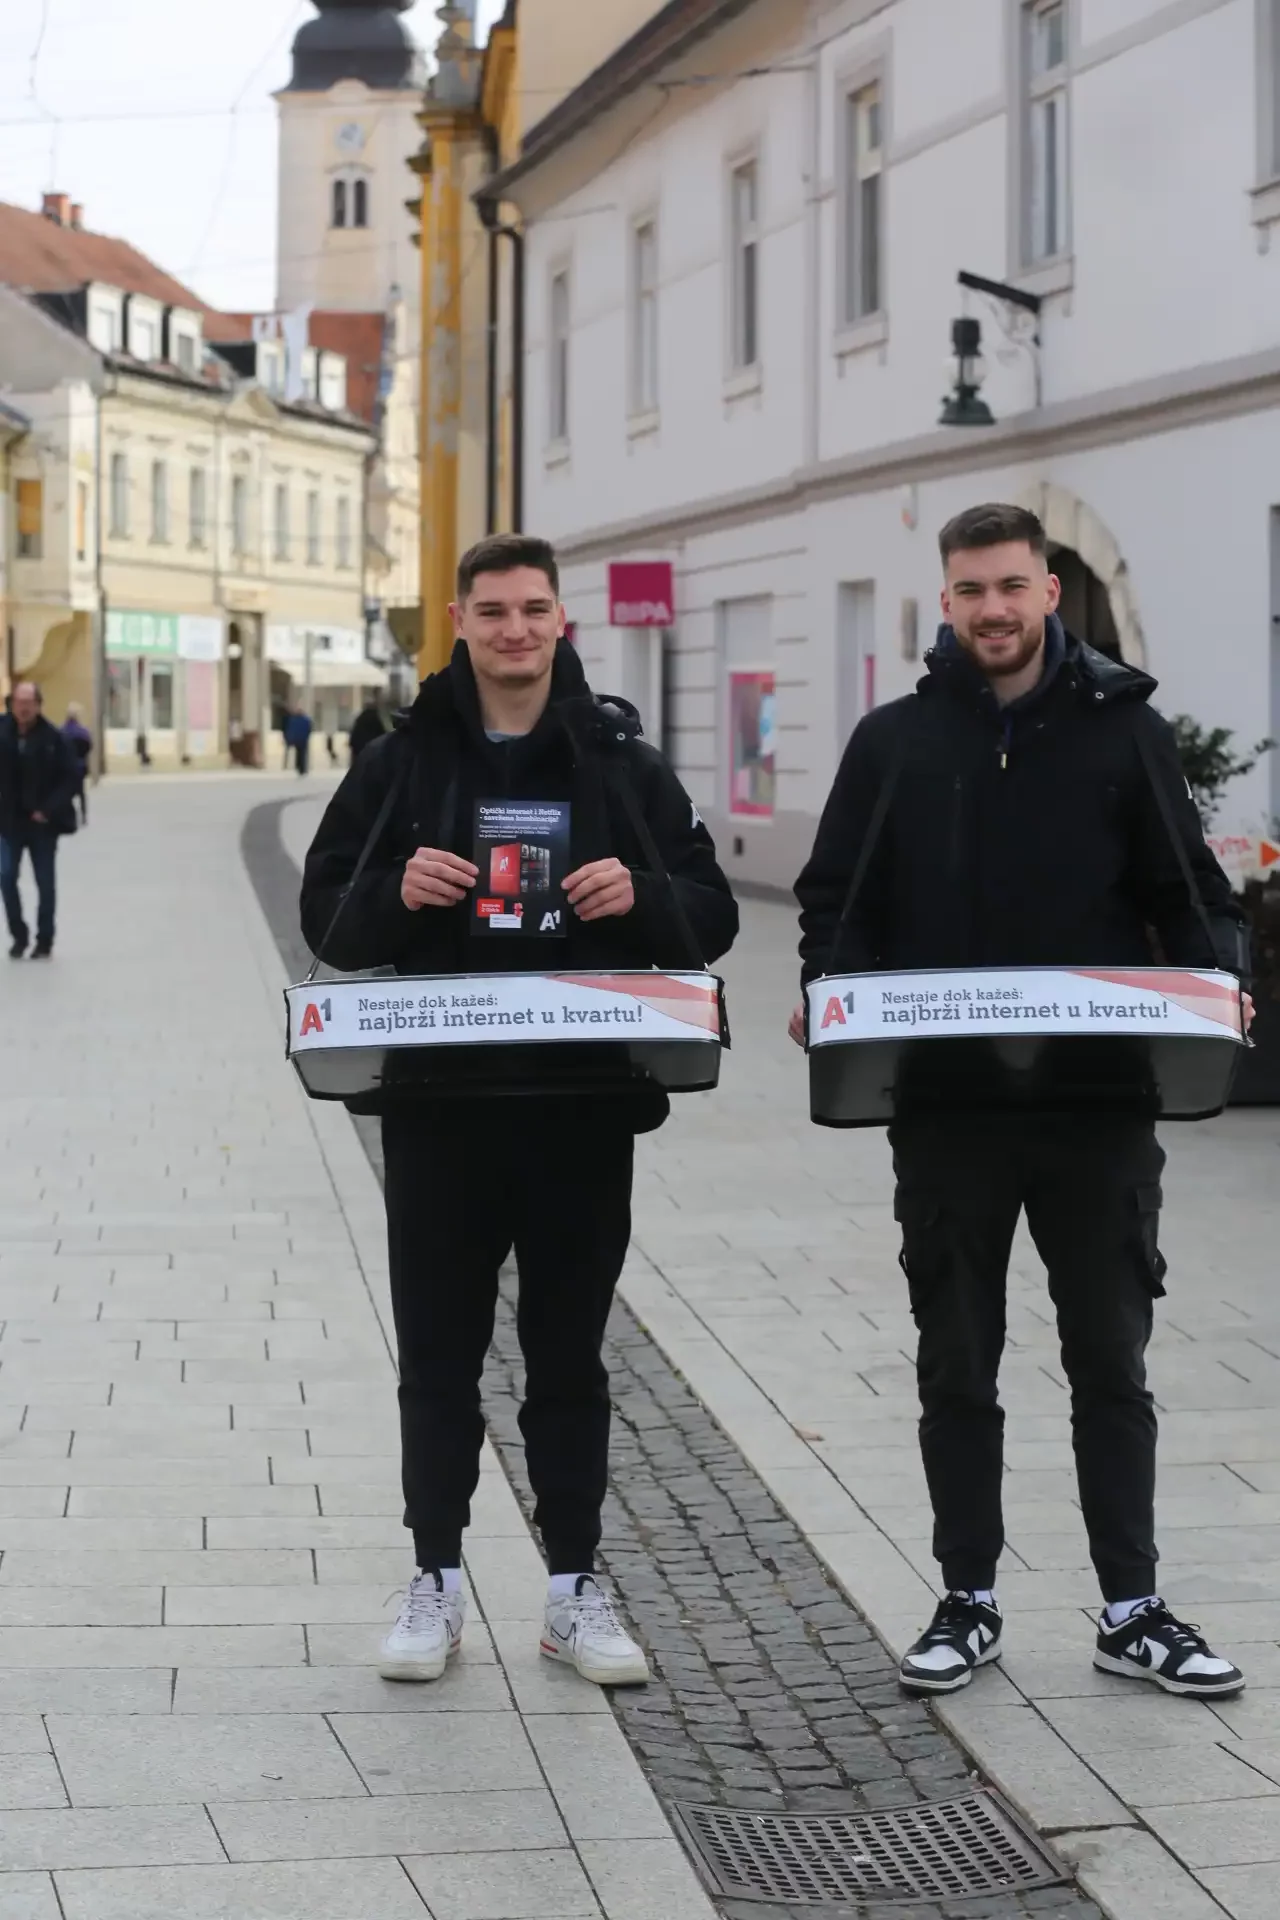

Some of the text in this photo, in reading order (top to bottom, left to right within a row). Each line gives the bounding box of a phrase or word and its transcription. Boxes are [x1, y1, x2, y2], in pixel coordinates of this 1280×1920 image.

[540, 909, 560, 931] A1
[358, 993, 498, 1012] Nestaje dok kažeš:
[882, 987, 1023, 1005] Nestaje dok kažeš:
[300, 998, 332, 1036] A1
[358, 1004, 643, 1034] najbrži internet u kvartu!
[820, 991, 855, 1029] A1
[882, 1000, 1168, 1026] najbrži internet u kvartu!
